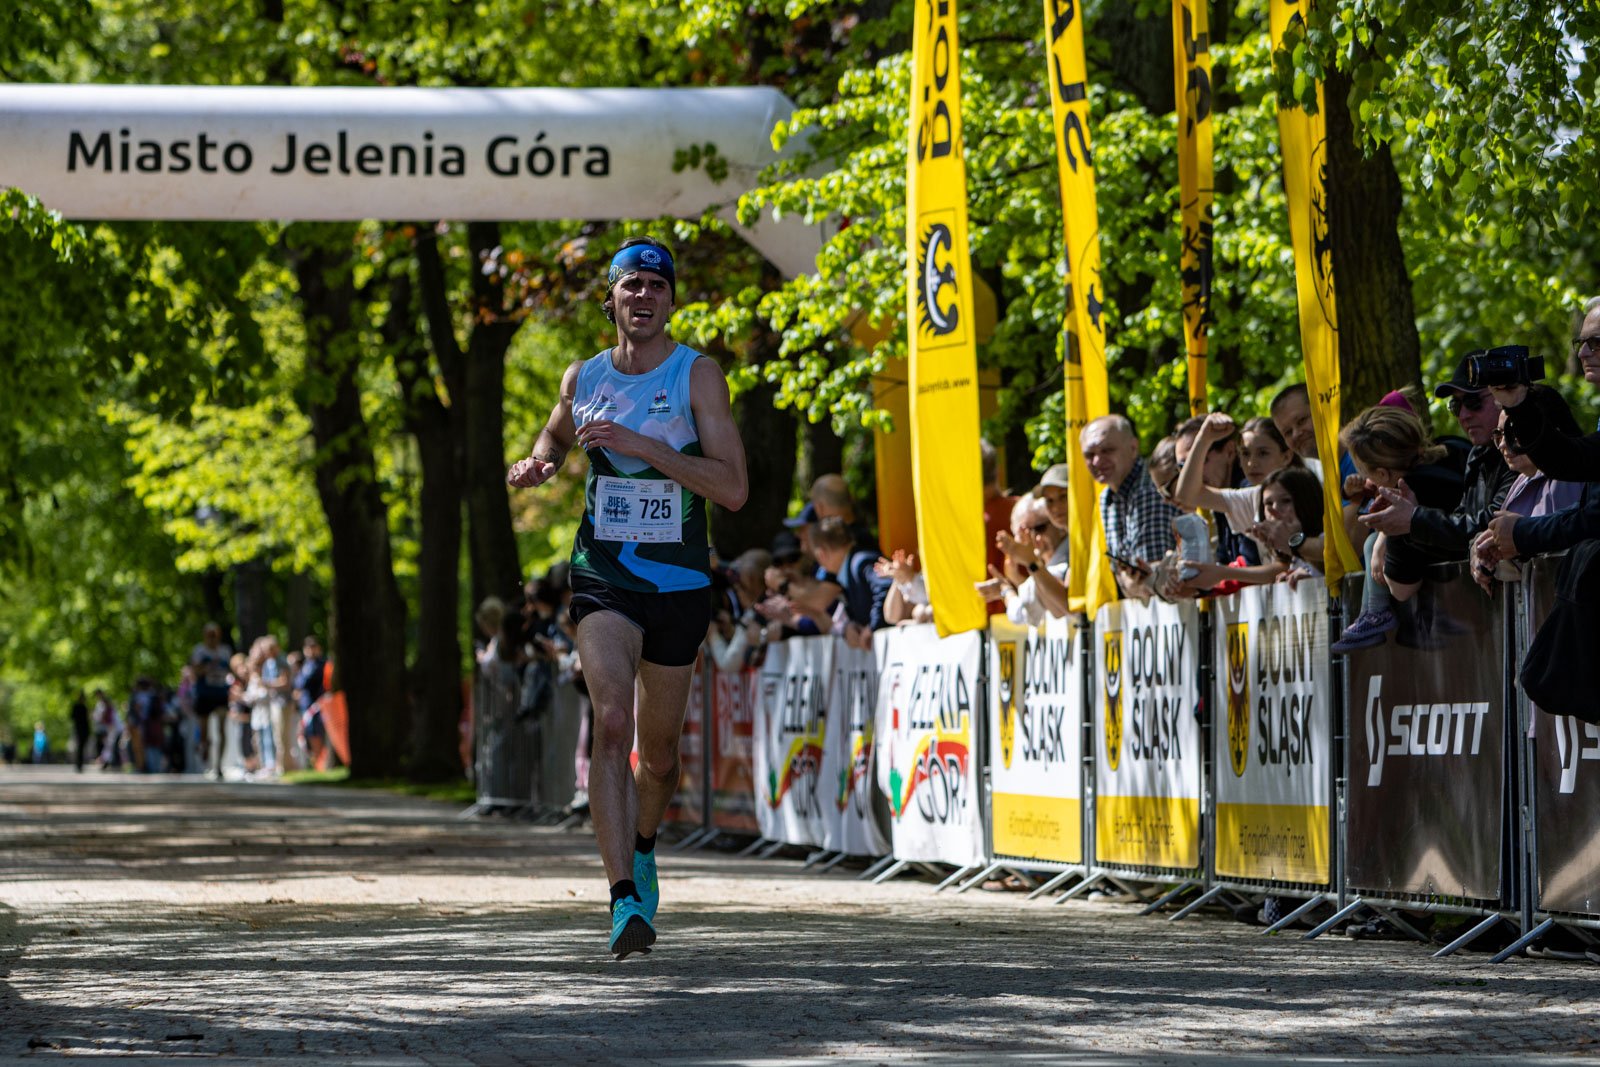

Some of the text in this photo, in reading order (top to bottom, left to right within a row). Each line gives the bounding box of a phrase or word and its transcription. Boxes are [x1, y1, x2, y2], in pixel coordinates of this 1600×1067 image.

[67, 127, 611, 178] Miasto Jelenia Góra
[639, 498, 672, 520] 725
[1024, 638, 1071, 695] DOLNY
[1132, 623, 1186, 688] DOLNY
[1258, 612, 1317, 685] DOLNY
[1132, 684, 1182, 771] ŚLĄSK
[1258, 680, 1313, 777] ŚLĄSK
[1387, 702, 1490, 756] SCOTT
